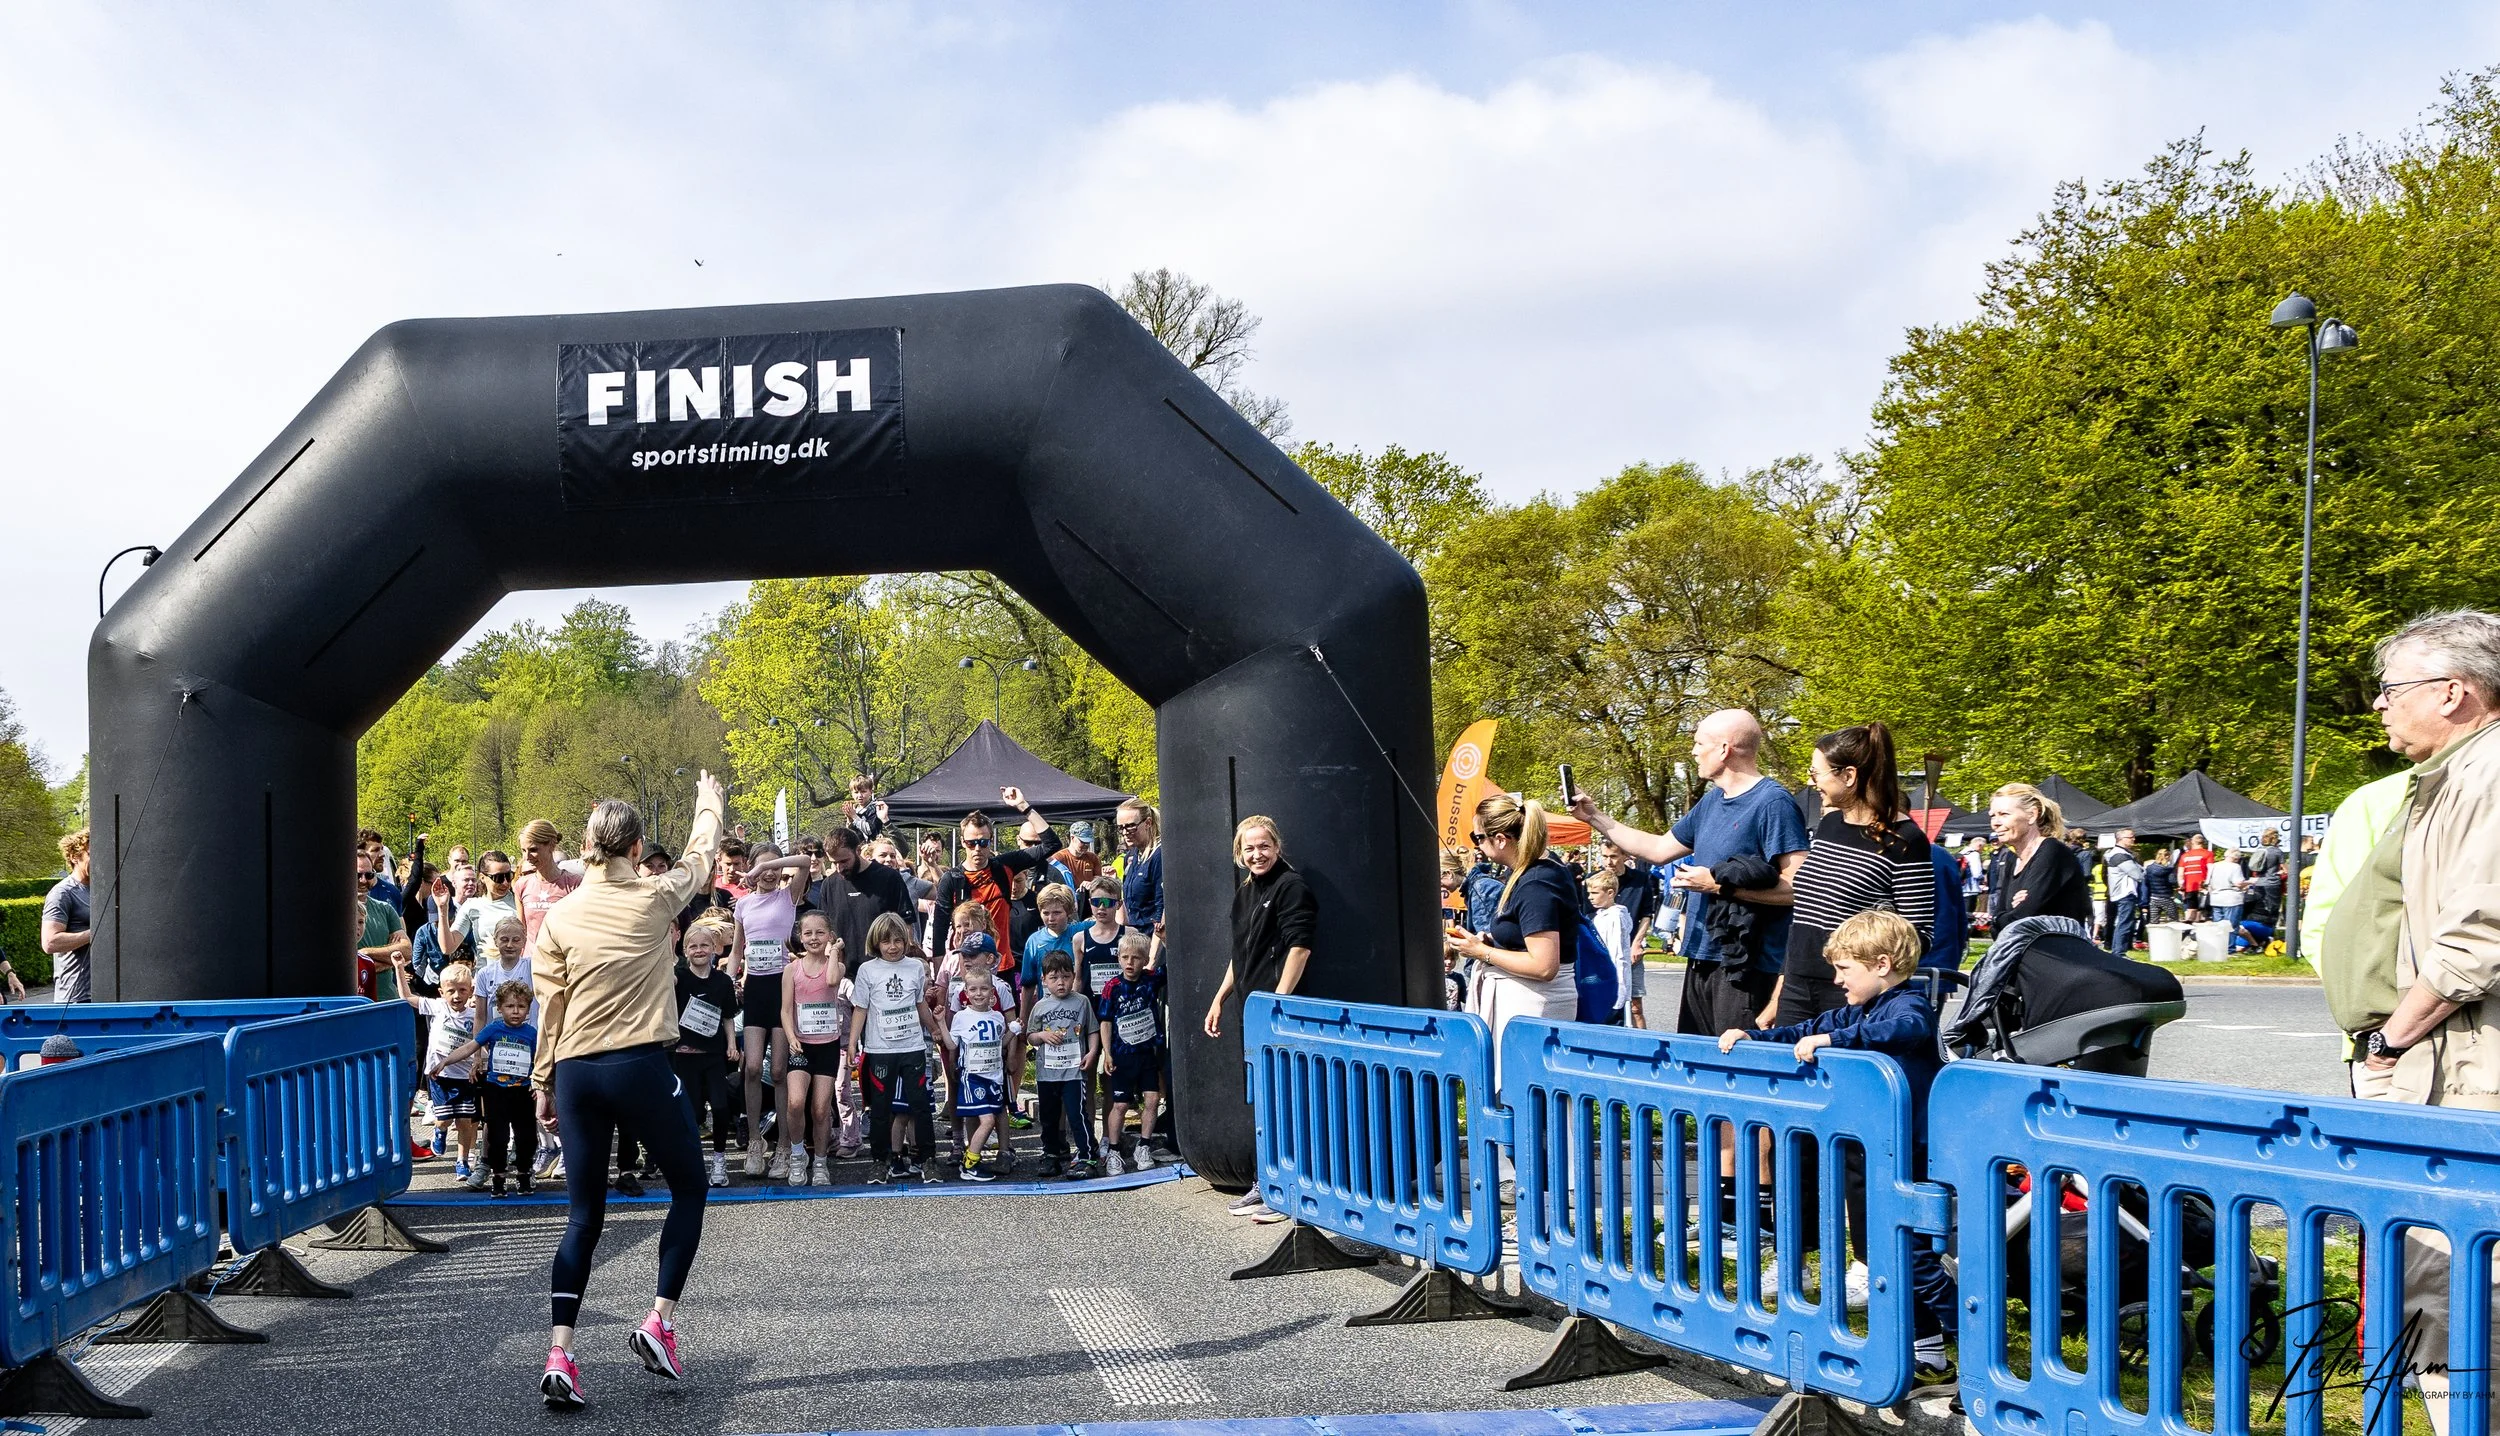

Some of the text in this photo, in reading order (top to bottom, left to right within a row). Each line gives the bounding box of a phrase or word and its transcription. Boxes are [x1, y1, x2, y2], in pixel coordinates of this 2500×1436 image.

[587, 357, 871, 426] FINISH
[631, 437, 830, 470] sportstiming.dk
[1446, 783, 1467, 846] busses
[977, 1020, 995, 1040] 21
[1122, 1017, 1150, 1028] ALEXANDER
[448, 1035, 466, 1043] VICTOR
